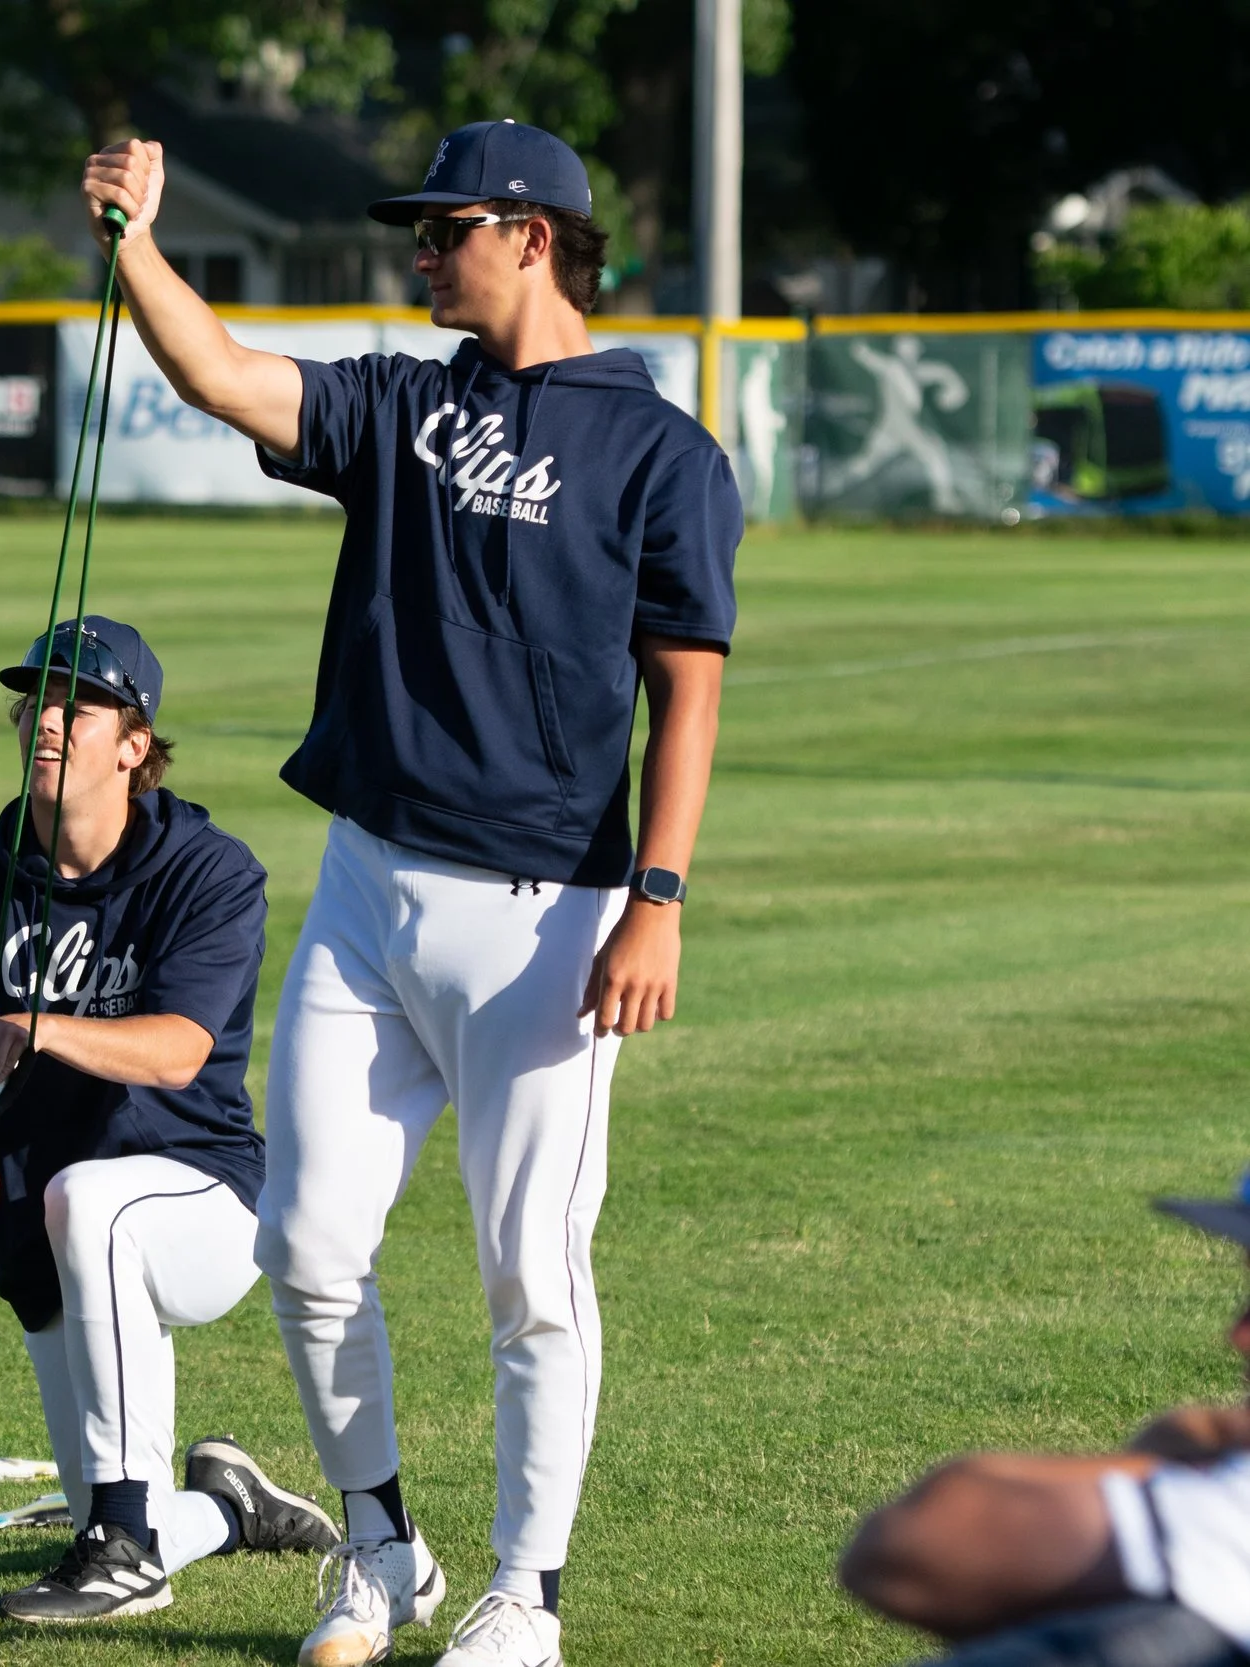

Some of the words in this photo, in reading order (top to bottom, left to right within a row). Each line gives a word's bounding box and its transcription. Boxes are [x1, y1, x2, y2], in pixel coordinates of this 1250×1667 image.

[1043, 334, 1145, 370] Catch
[414, 403, 561, 511] Clips
[471, 494, 549, 525] BASEBALL
[2, 921, 146, 1017] Clips
[224, 1468, 255, 1513] ADIZERO
